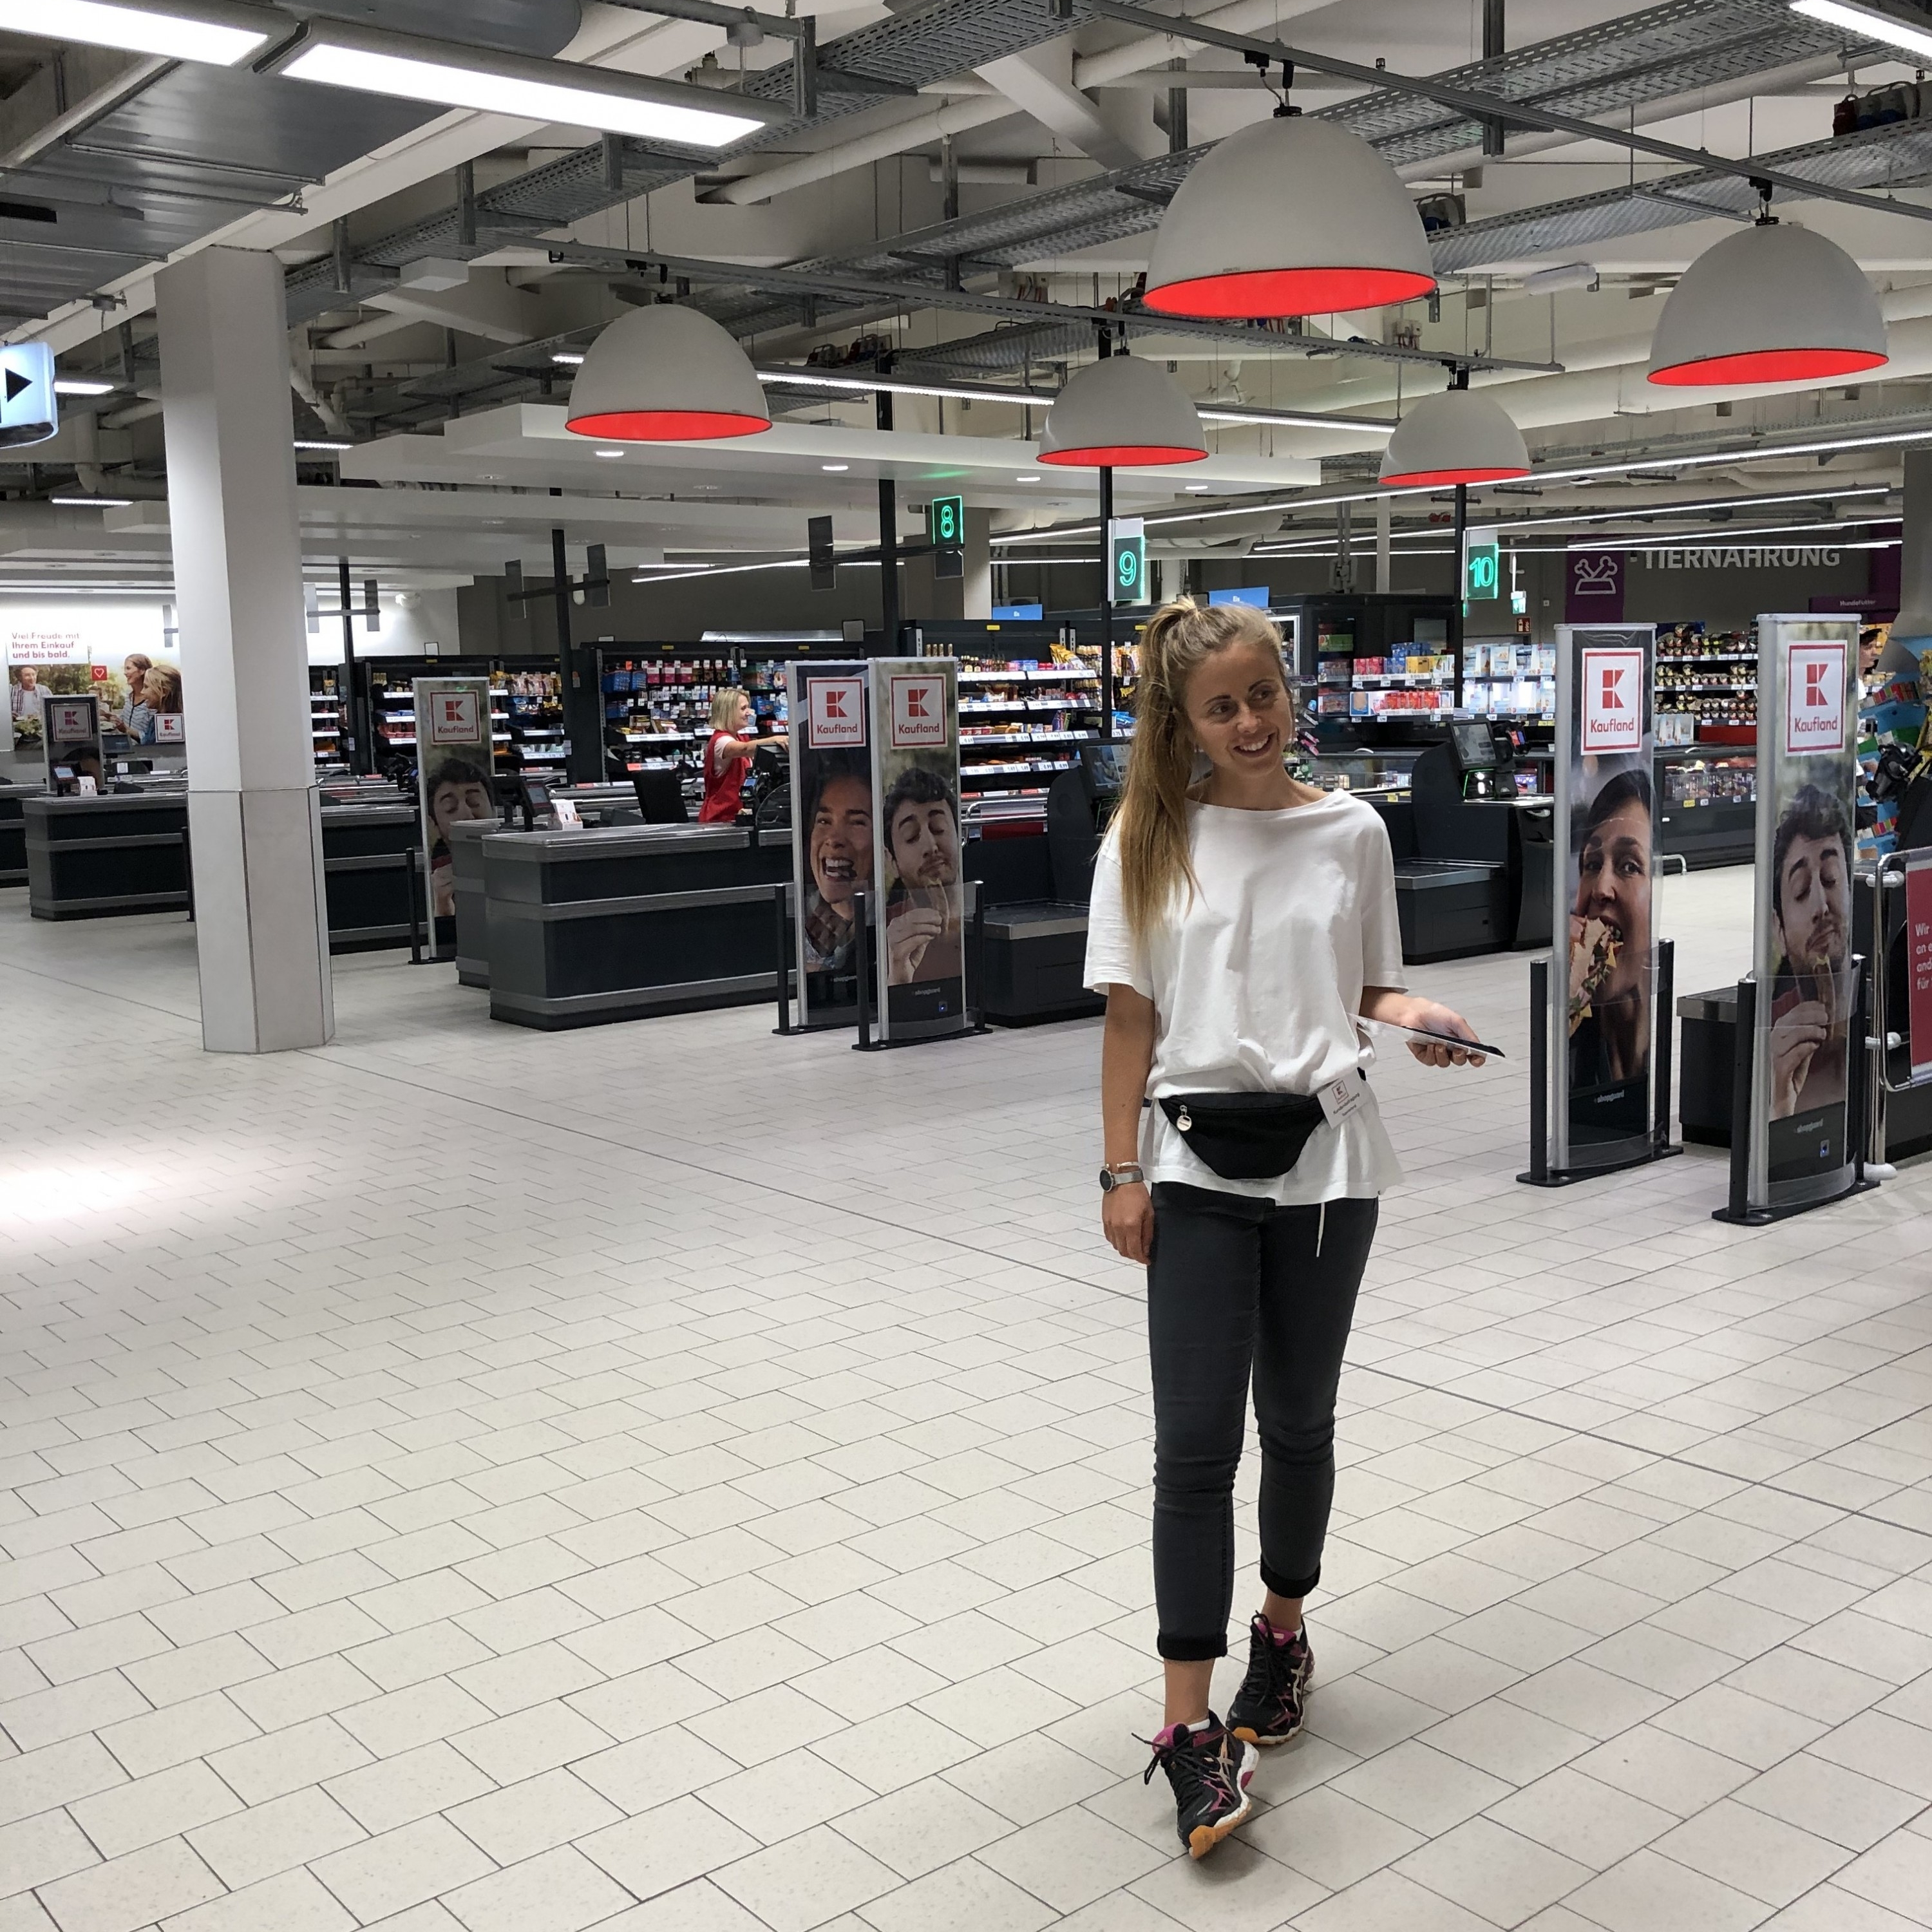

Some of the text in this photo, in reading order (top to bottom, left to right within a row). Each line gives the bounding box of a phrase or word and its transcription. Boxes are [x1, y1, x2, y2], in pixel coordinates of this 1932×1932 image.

[941, 505, 954, 539] 8
[1644, 548, 1841, 569] TIERNAHRUNG
[1119, 551, 1137, 587] 9
[1469, 556, 1494, 588] 10
[41, 641, 74, 649] Einkauf
[13, 650, 30, 659] und
[32, 650, 45, 659] bis
[438, 725, 473, 734] Kaufland
[817, 723, 858, 734] Kaufland
[899, 723, 940, 734] Kaufland
[1591, 717, 1634, 733] Kaufland
[1794, 715, 1838, 732] Kaufland
[1915, 923, 1930, 937] Wir
[1916, 944, 1926, 955] an
[1917, 977, 1929, 990] für
